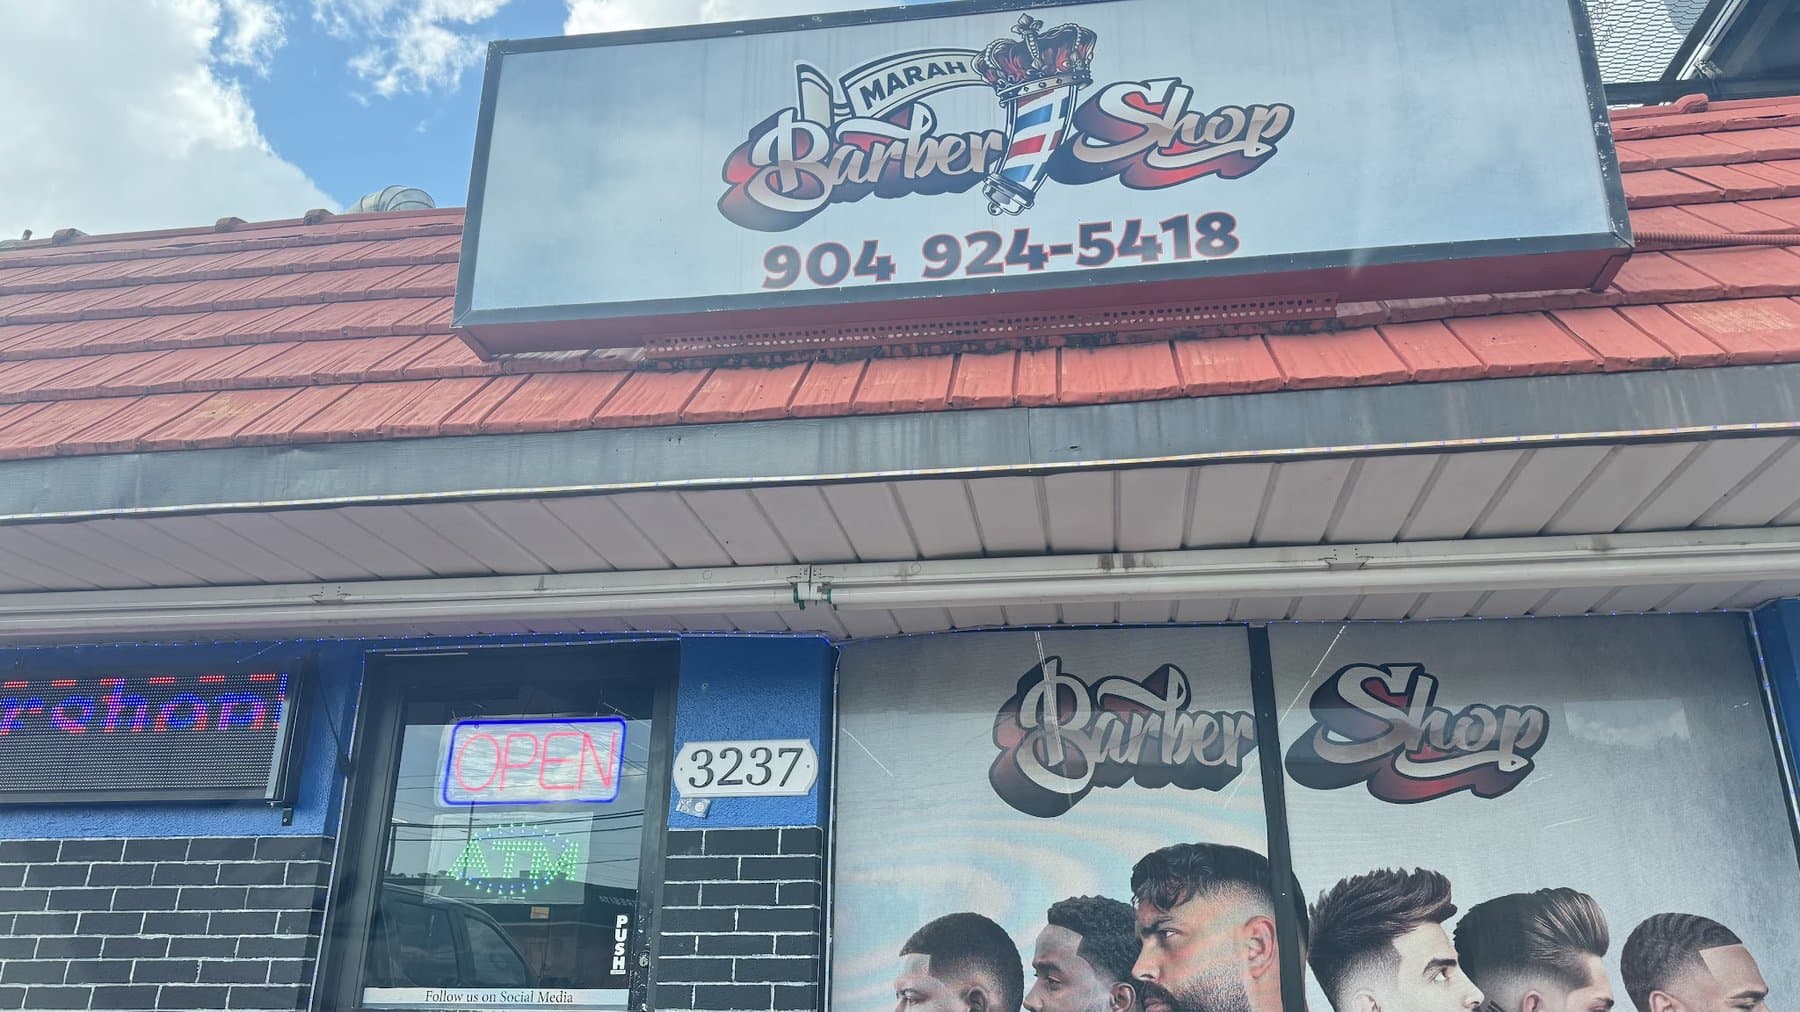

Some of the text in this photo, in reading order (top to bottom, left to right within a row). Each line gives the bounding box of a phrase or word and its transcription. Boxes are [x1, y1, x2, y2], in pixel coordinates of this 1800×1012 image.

[859, 60, 967, 111] MARAH
[742, 77, 1295, 215] Barber Shop
[762, 211, 1240, 289] 904 924-5418
[1013, 655, 1550, 796] Barber Shop
[456, 730, 617, 793] OPEN
[688, 746, 804, 789] 3237
[446, 838, 579, 881] ATM
[612, 914, 629, 970] PUSH
[425, 990, 573, 1003] Follow us on Social Media
